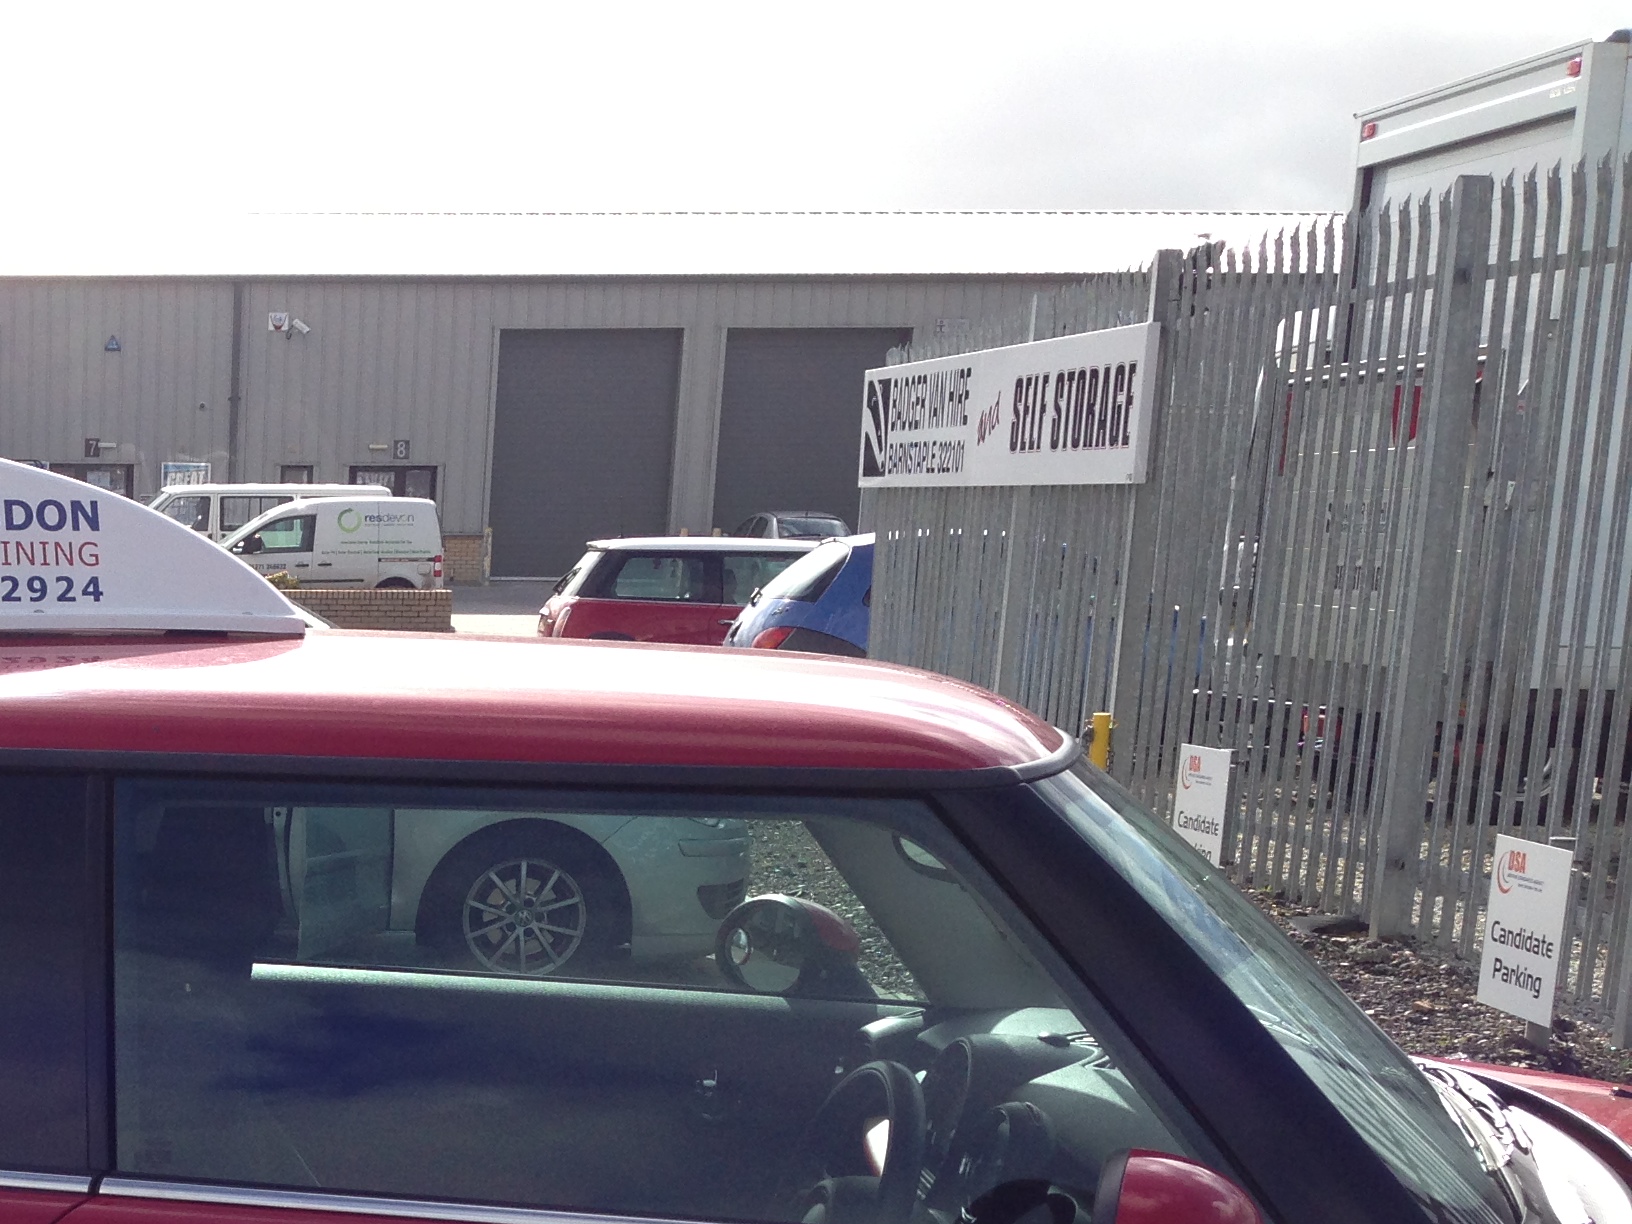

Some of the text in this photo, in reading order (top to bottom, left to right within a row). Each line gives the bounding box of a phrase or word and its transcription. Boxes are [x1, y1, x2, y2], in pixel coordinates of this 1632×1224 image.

[890, 367, 972, 432] BADGER VAN HIRE
[1009, 360, 1139, 455] SELF STORAGE
[88, 440, 97, 456] 7
[396, 441, 406, 458] 8
[887, 441, 937, 475] BARNSTAPLE
[1177, 810, 1220, 837] Candidate
[1508, 850, 1527, 875] DSA
[1490, 920, 1555, 960] Candidate
[1491, 957, 1543, 1000] Parking
